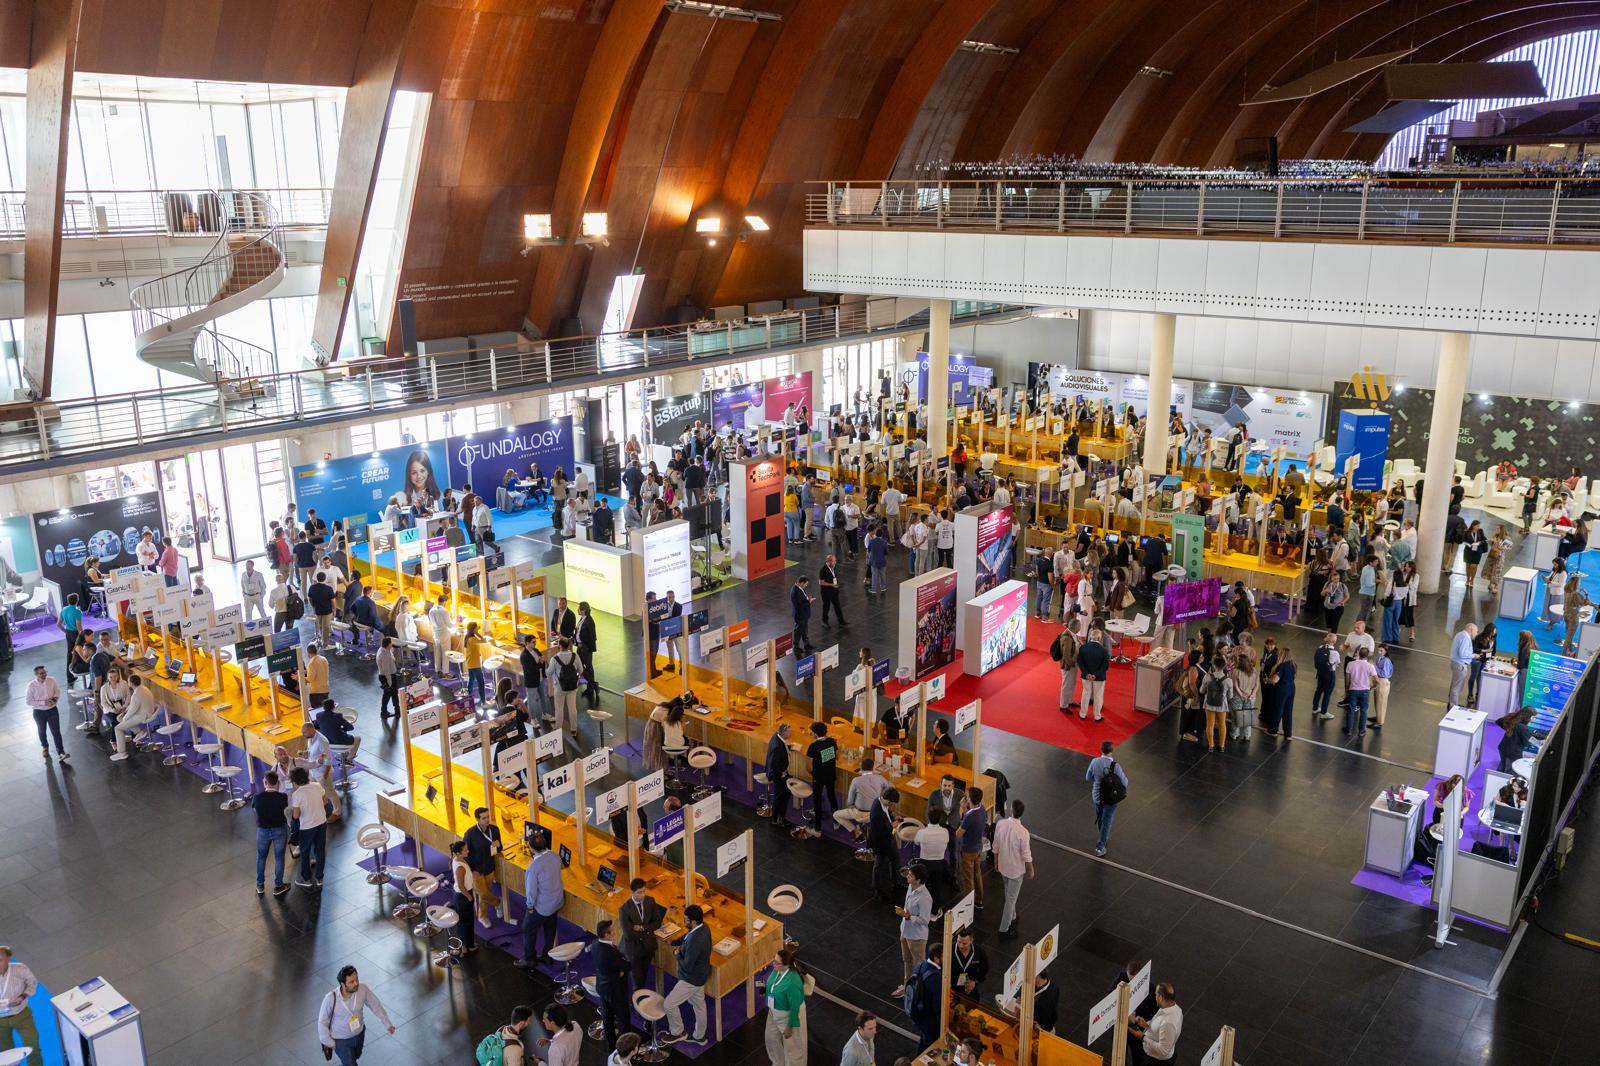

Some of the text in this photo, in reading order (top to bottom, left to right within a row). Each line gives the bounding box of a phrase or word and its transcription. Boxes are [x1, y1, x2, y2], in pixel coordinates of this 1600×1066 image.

[1065, 374, 1104, 385] SOLUCIONES
[1060, 382, 1109, 392] AUDIOVISUALES
[654, 396, 701, 428] BStartup
[473, 428, 562, 460] FUNDALOGY
[362, 468, 390, 479] CREAR
[362, 474, 390, 485] FUTURO
